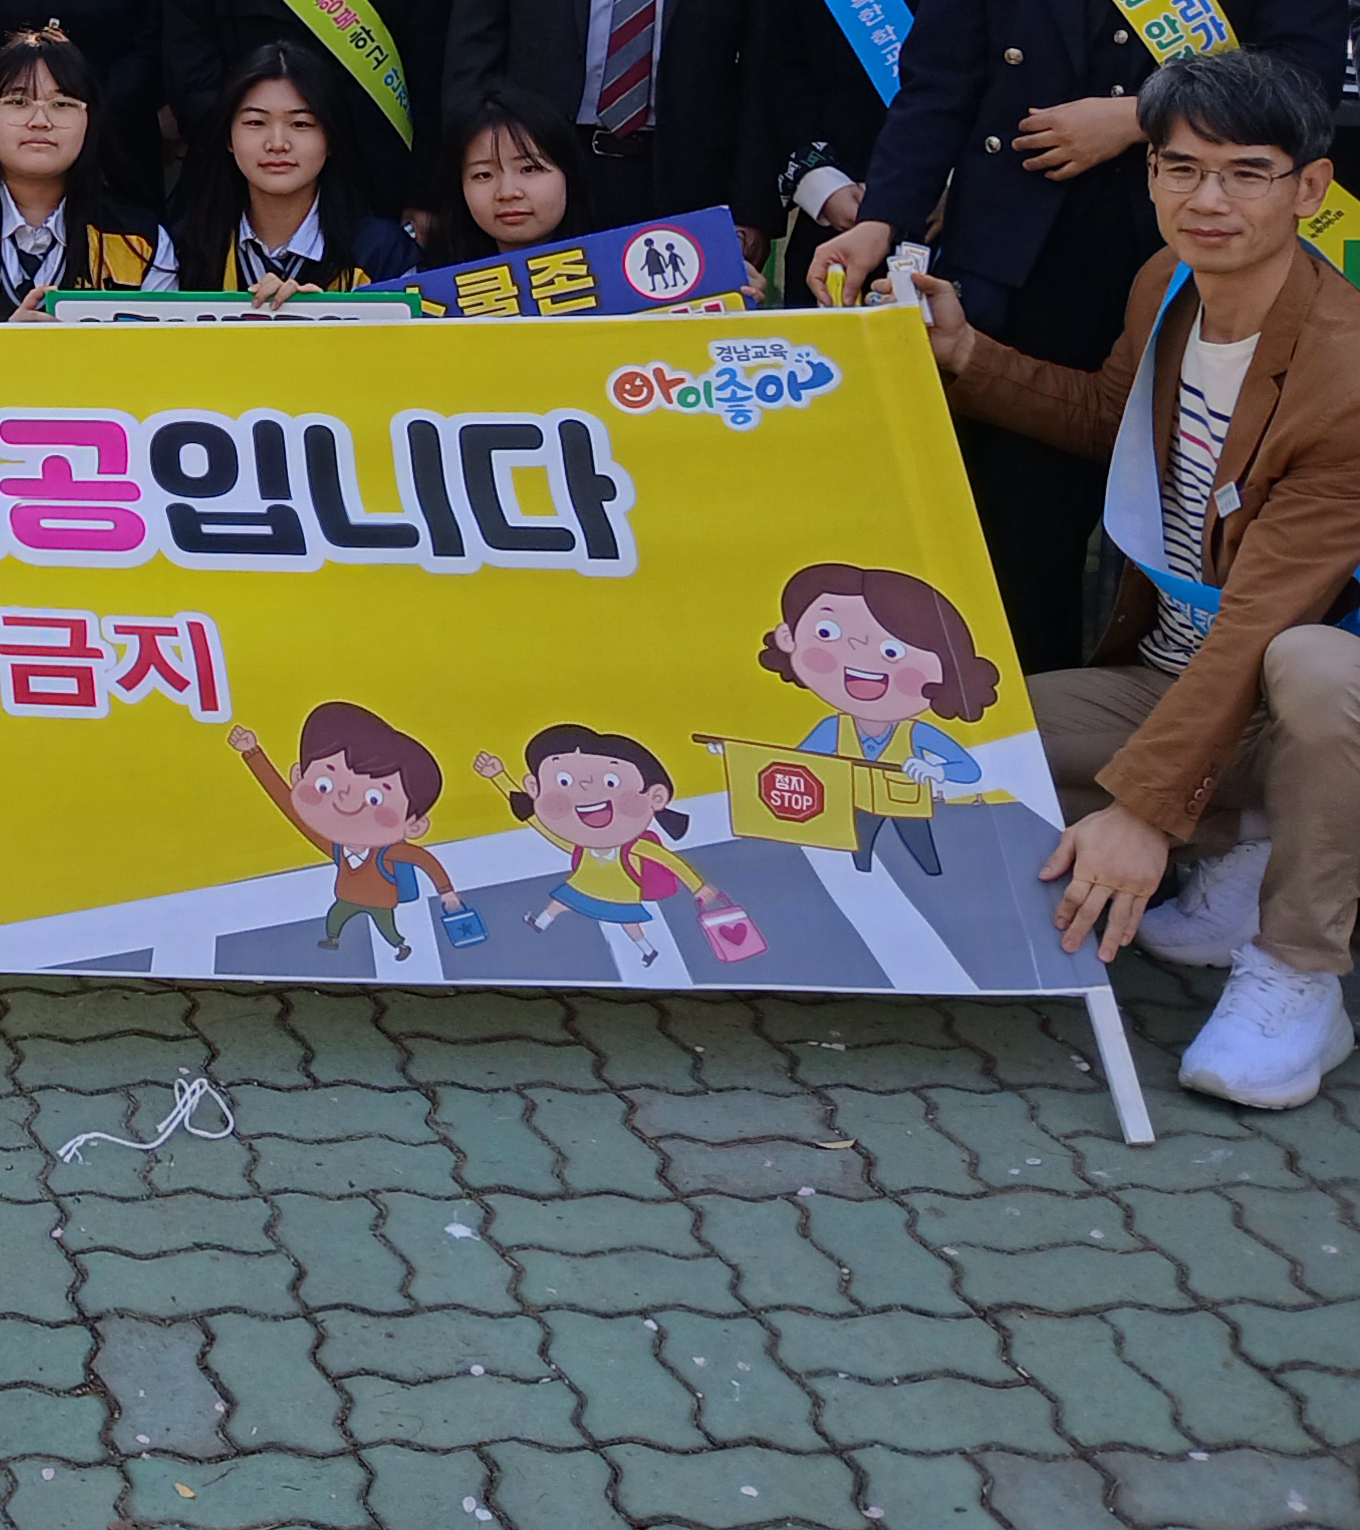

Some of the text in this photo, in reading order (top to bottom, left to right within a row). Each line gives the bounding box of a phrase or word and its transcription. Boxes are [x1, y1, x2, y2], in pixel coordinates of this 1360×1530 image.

[871, 23, 903, 78] 학교
[715, 342, 789, 363] 경남교육
[612, 358, 836, 426] 아이좋아
[774, 773, 806, 793] 정지
[770, 790, 814, 812] STOP
